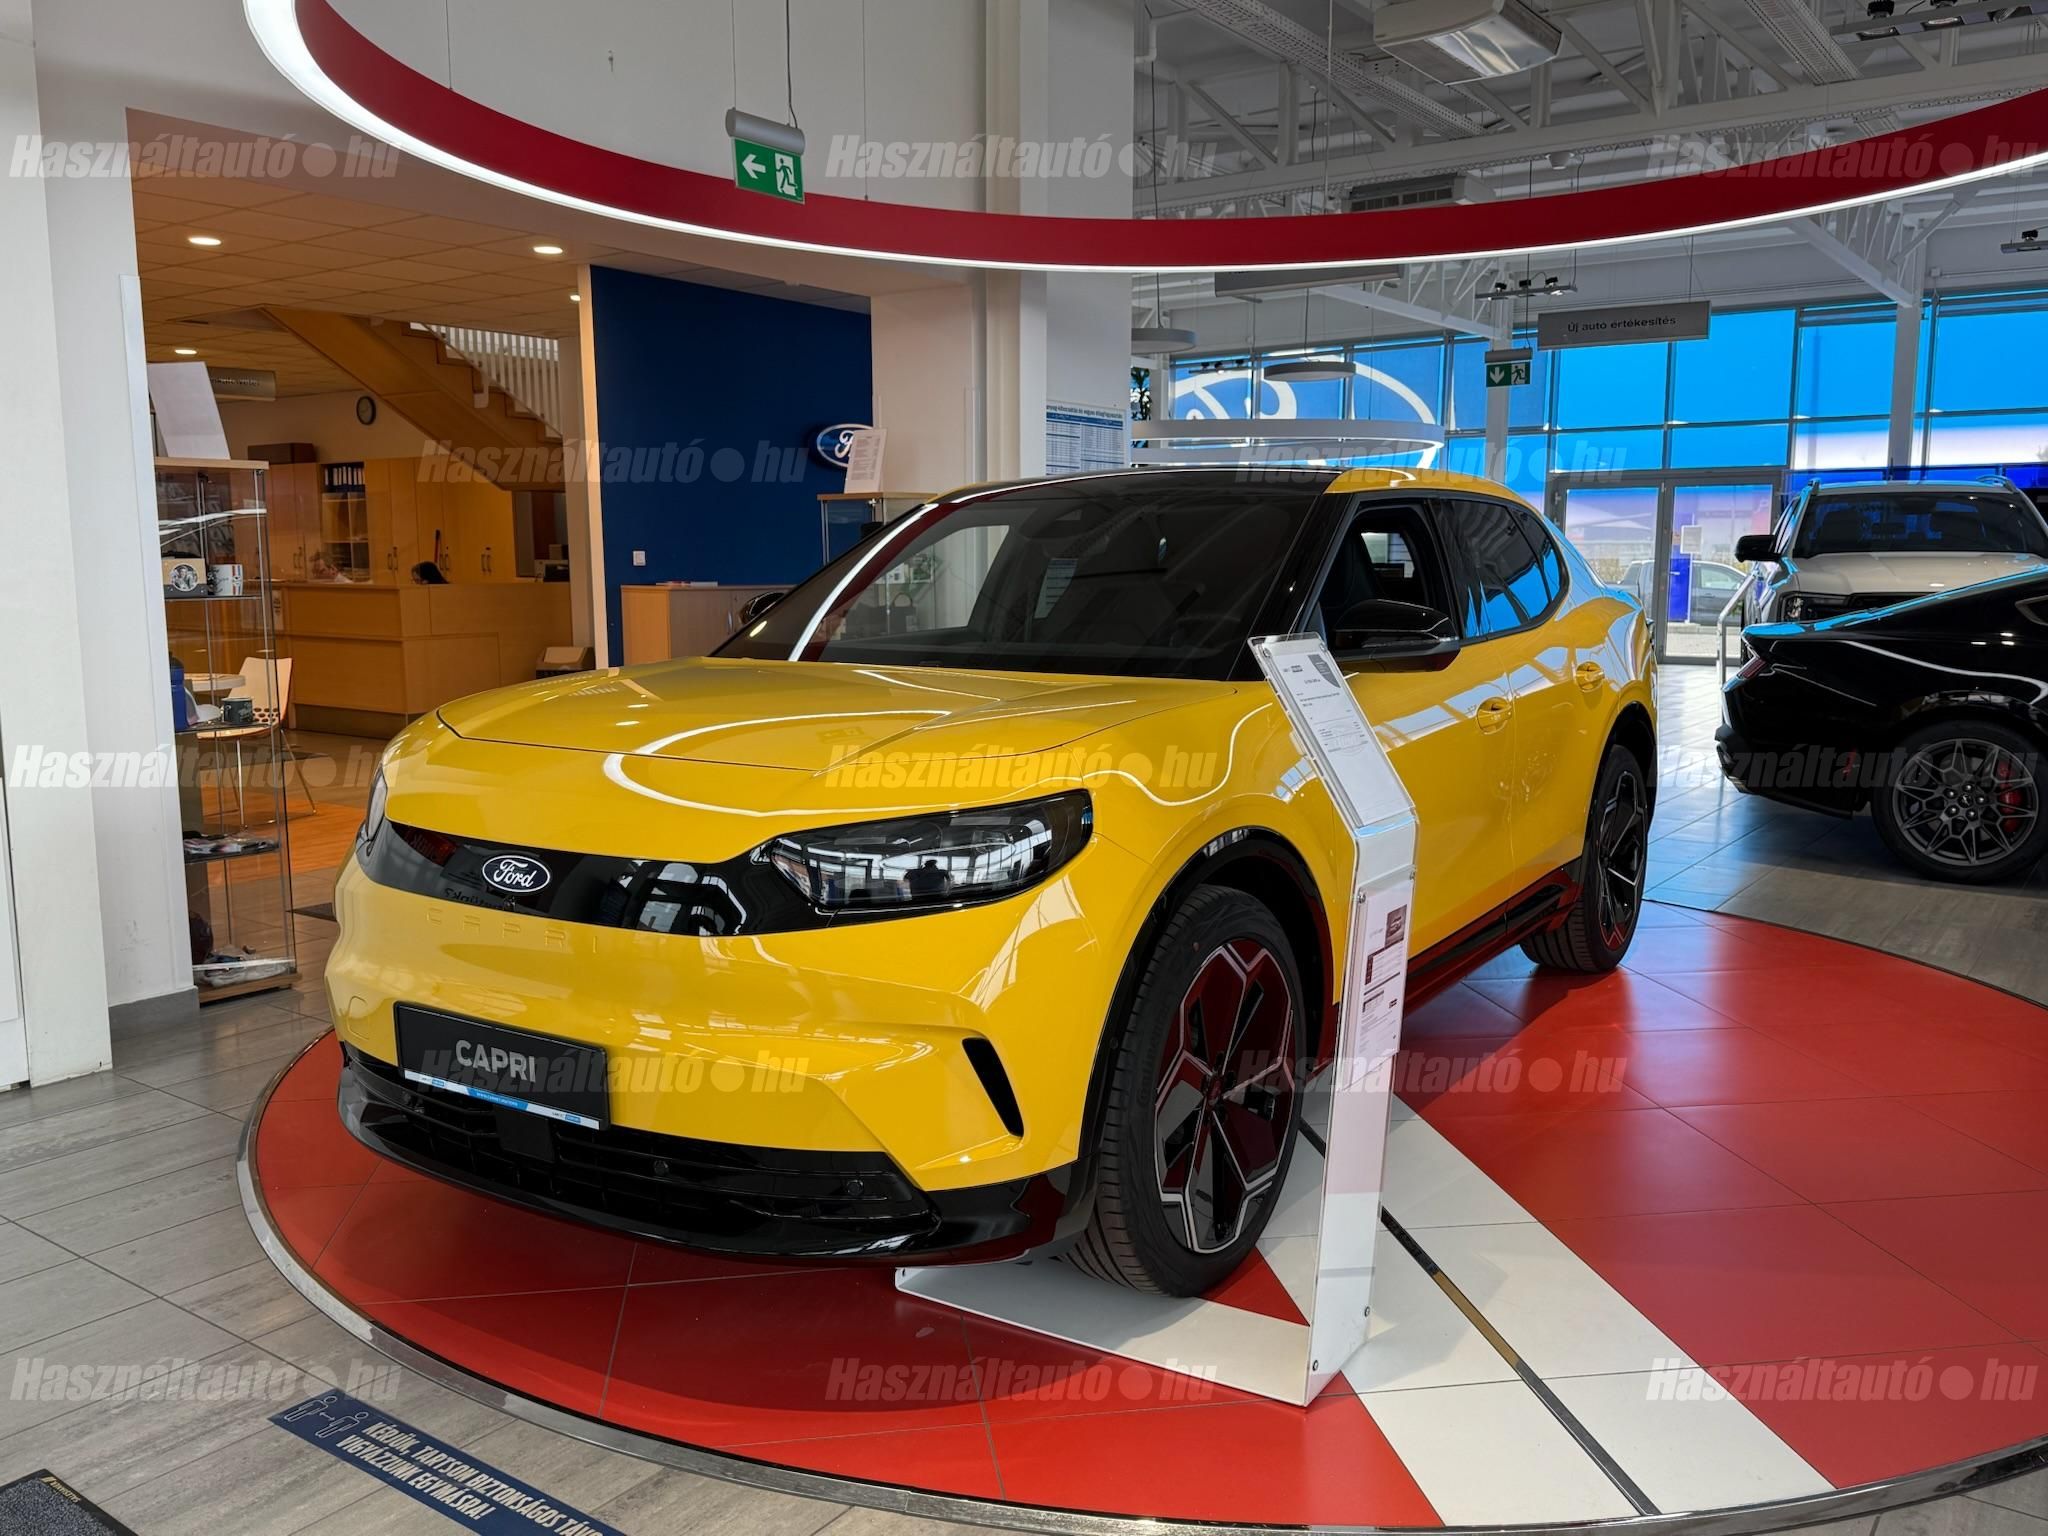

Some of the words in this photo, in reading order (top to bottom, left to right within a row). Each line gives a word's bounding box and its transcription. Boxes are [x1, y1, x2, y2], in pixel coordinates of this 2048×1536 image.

[493, 858, 538, 888] Ford
[426, 907, 598, 954] CAPRI
[455, 1039, 536, 1083] CAPRI
[336, 1434, 421, 1481] VIGYÁZZUNK
[407, 1469, 497, 1521] EGYMÁSRA!
[361, 1421, 420, 1454] KÉRJÜK,
[411, 1445, 480, 1485] TARTSON
[466, 1471, 568, 1528] BIZTONSÁGOS
